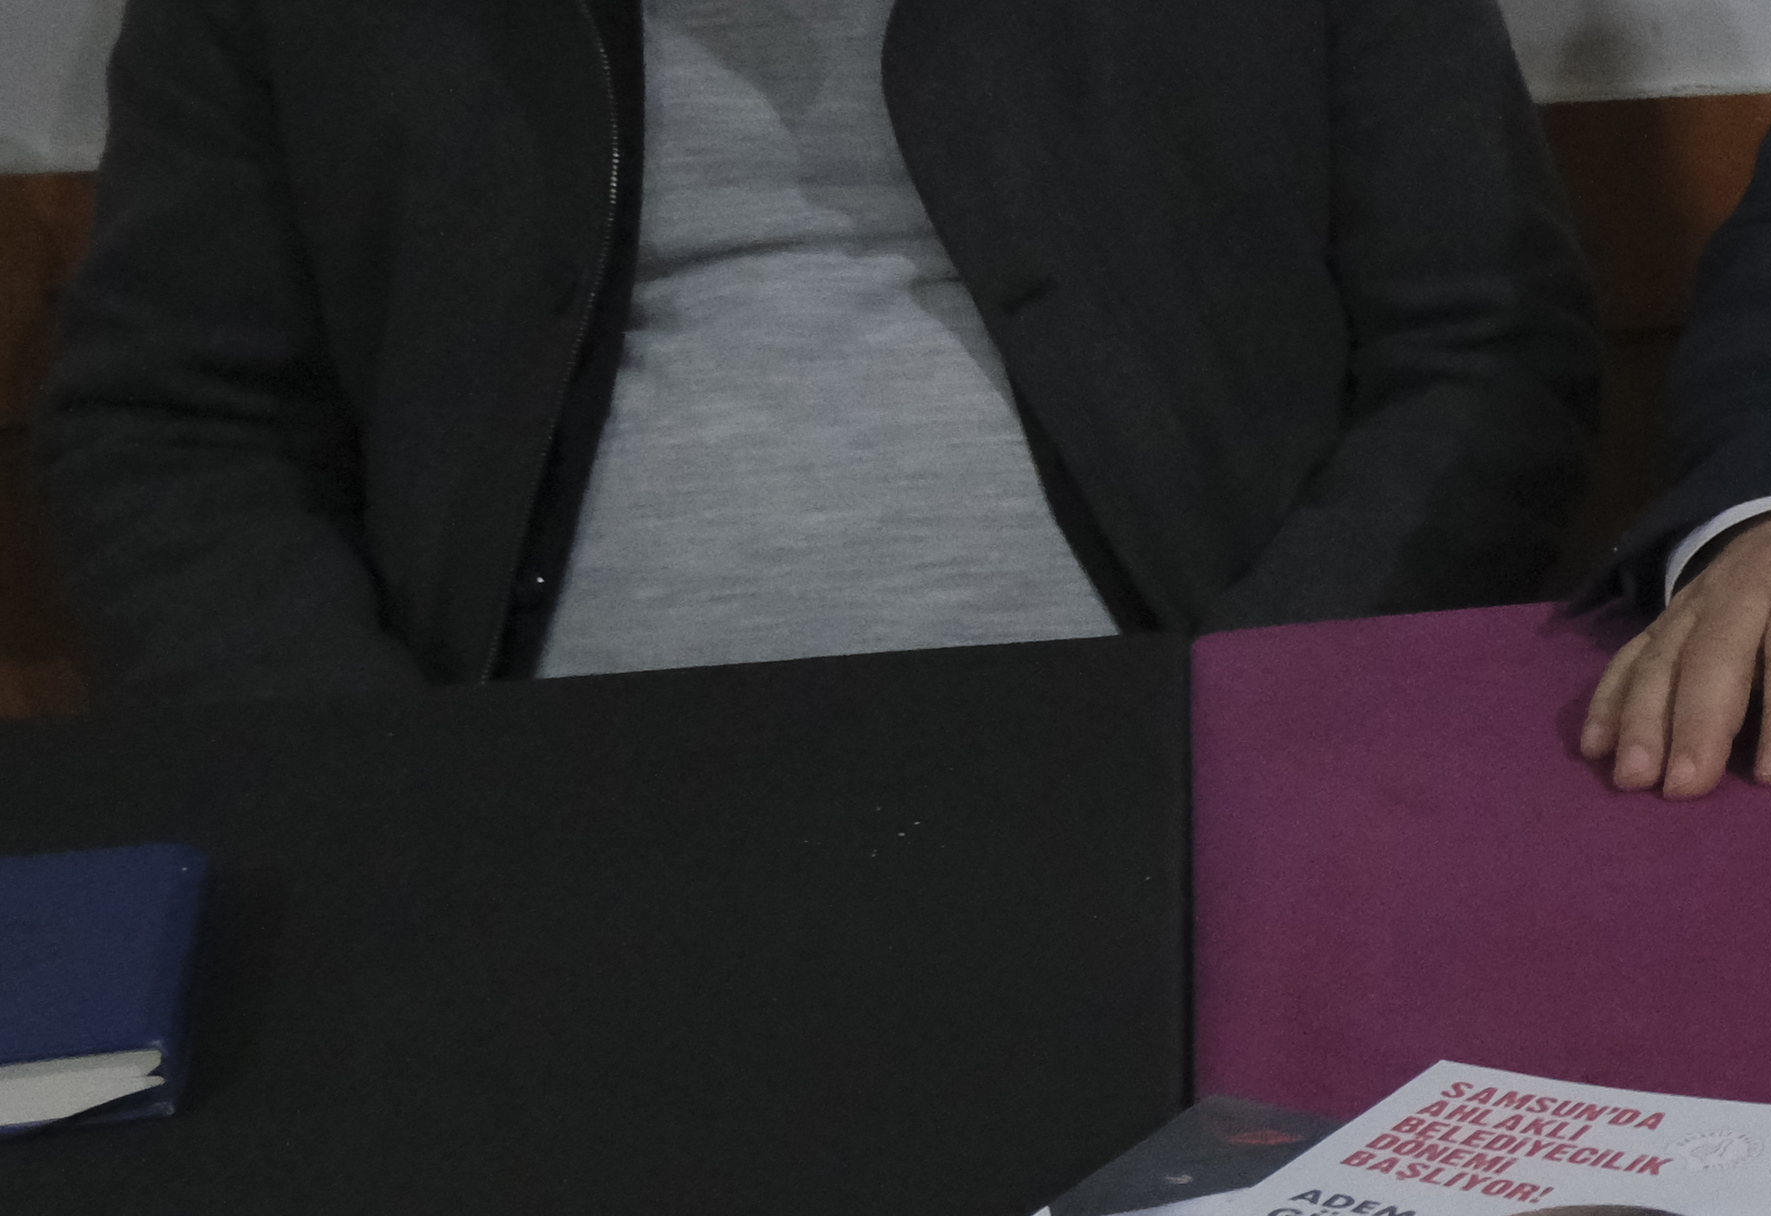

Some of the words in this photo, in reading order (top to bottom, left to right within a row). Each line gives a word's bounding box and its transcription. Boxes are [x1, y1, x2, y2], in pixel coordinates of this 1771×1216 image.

[1416, 1099, 1593, 1143] AHLAKLI
[1440, 1081, 1667, 1132] SAMSUN'DA
[1339, 1150, 1555, 1204] BAŞLIYOR!
[1289, 1188, 1417, 1216] ADEM
